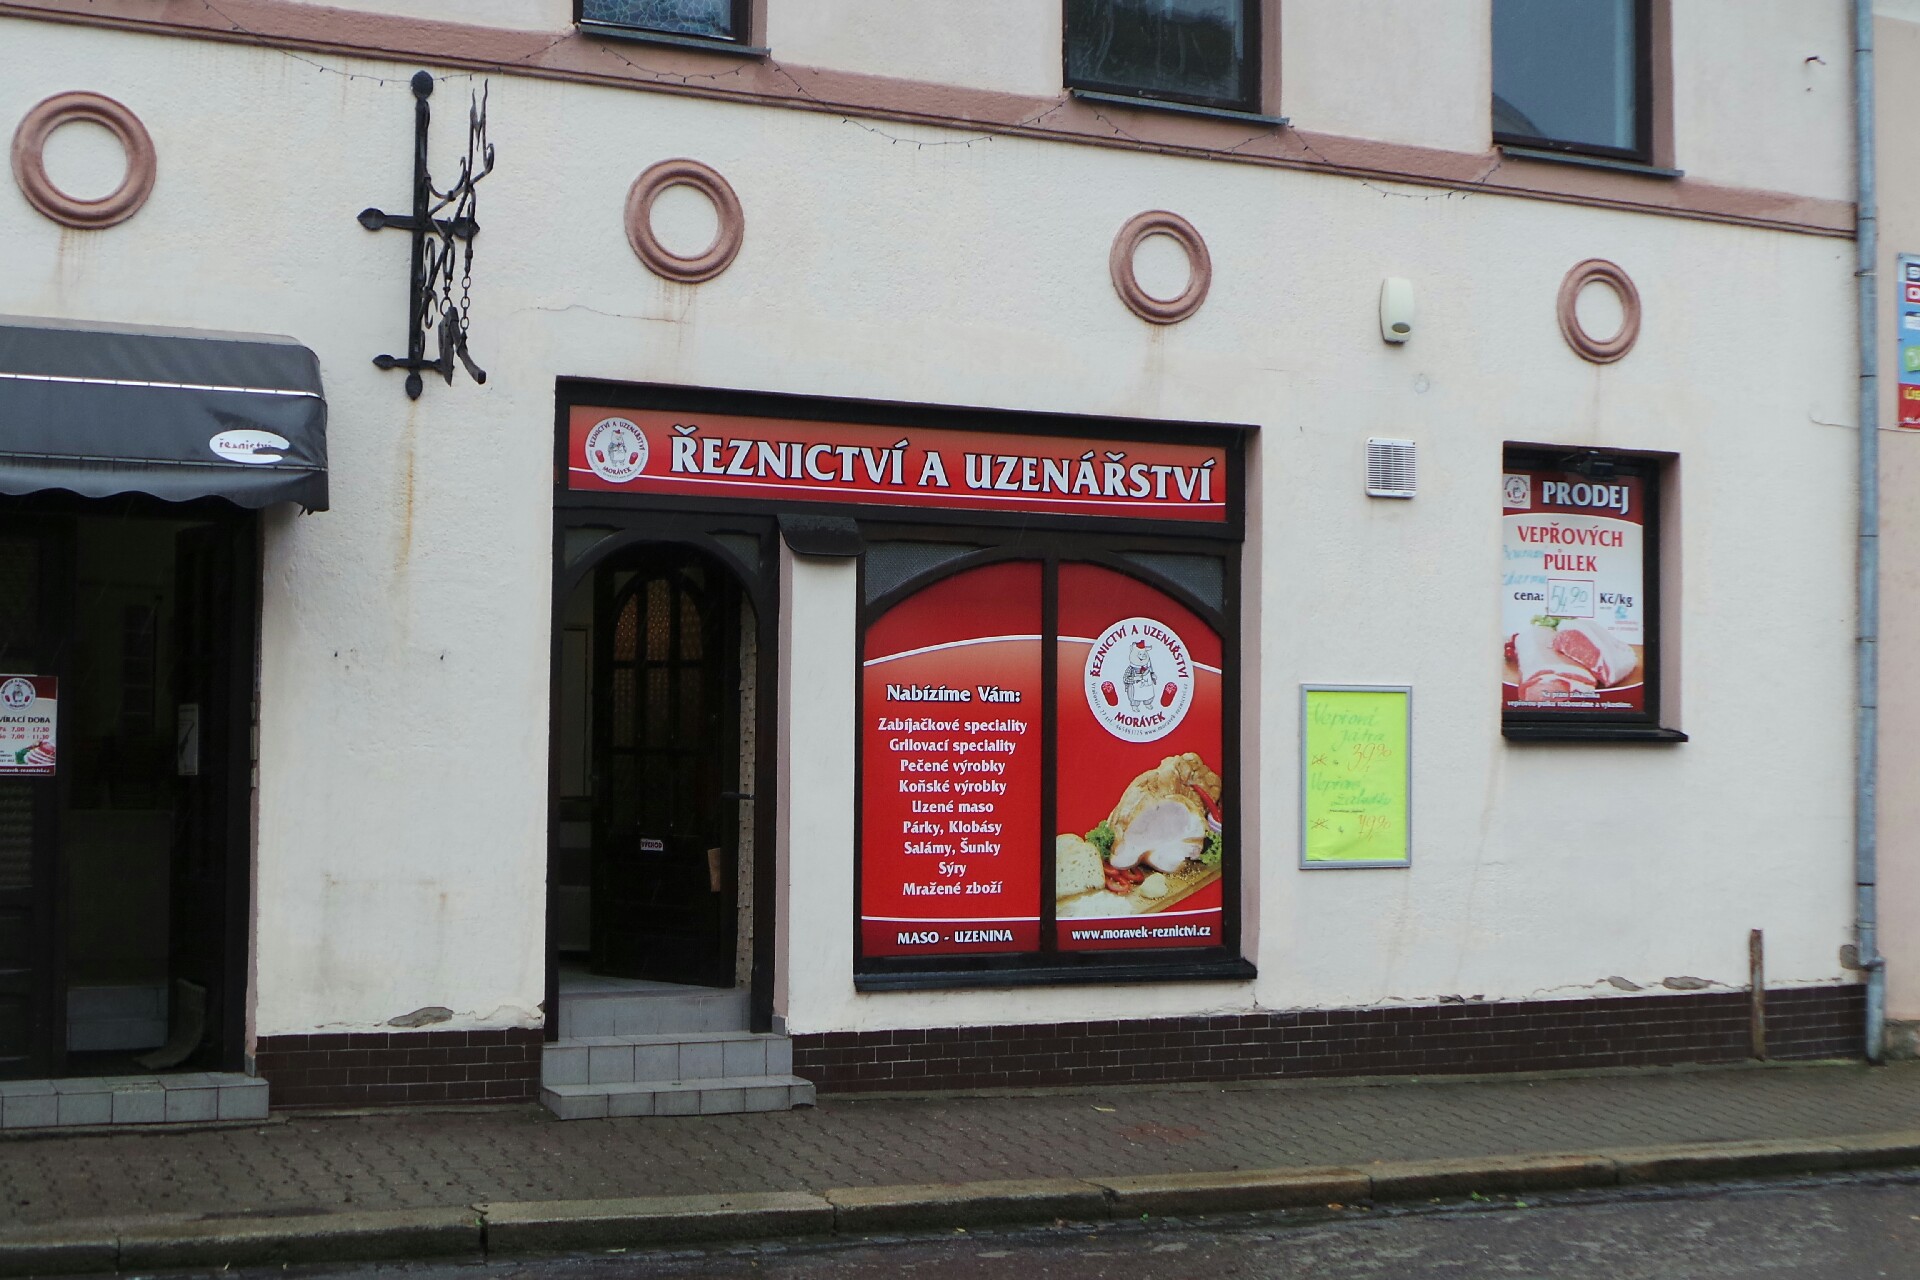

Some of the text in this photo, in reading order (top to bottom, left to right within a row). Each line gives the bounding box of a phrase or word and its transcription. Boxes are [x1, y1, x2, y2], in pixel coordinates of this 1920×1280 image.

[668, 424, 1216, 502] ŘEZNICTVÍ A UZENÁŘSTVÍ
[1541, 480, 1629, 515] PRODEJ
[1517, 522, 1623, 547] VEPŘOVÝCH
[1544, 549, 1598, 572] PŮLEK
[1513, 591, 1544, 601] cena:
[1600, 592, 1633, 608] Kč/kg
[1090, 625, 1189, 678] ŘEZNICTVÍ A UZENÁŘSTVÍ
[886, 684, 1021, 702] Nabízíme Vám:
[878, 717, 1028, 735] Zabíjačkové speciality
[1114, 711, 1166, 728] MORÁVEK
[889, 738, 1016, 755] Grilovací speciality
[900, 759, 1006, 776] Pečené výrobky
[899, 779, 1007, 796] Koňské výrobky
[912, 800, 994, 813] Uzené maso
[903, 820, 1002, 837] Párky, Klobásy
[904, 837, 1001, 857] Salámy, Šunky
[938, 861, 967, 877] Sýry
[903, 881, 1003, 896] Mražené zboží
[897, 931, 940, 945] MASO
[954, 929, 1013, 943] UZENINA
[1072, 924, 1211, 940] www.moravek-reznictvi.cz
